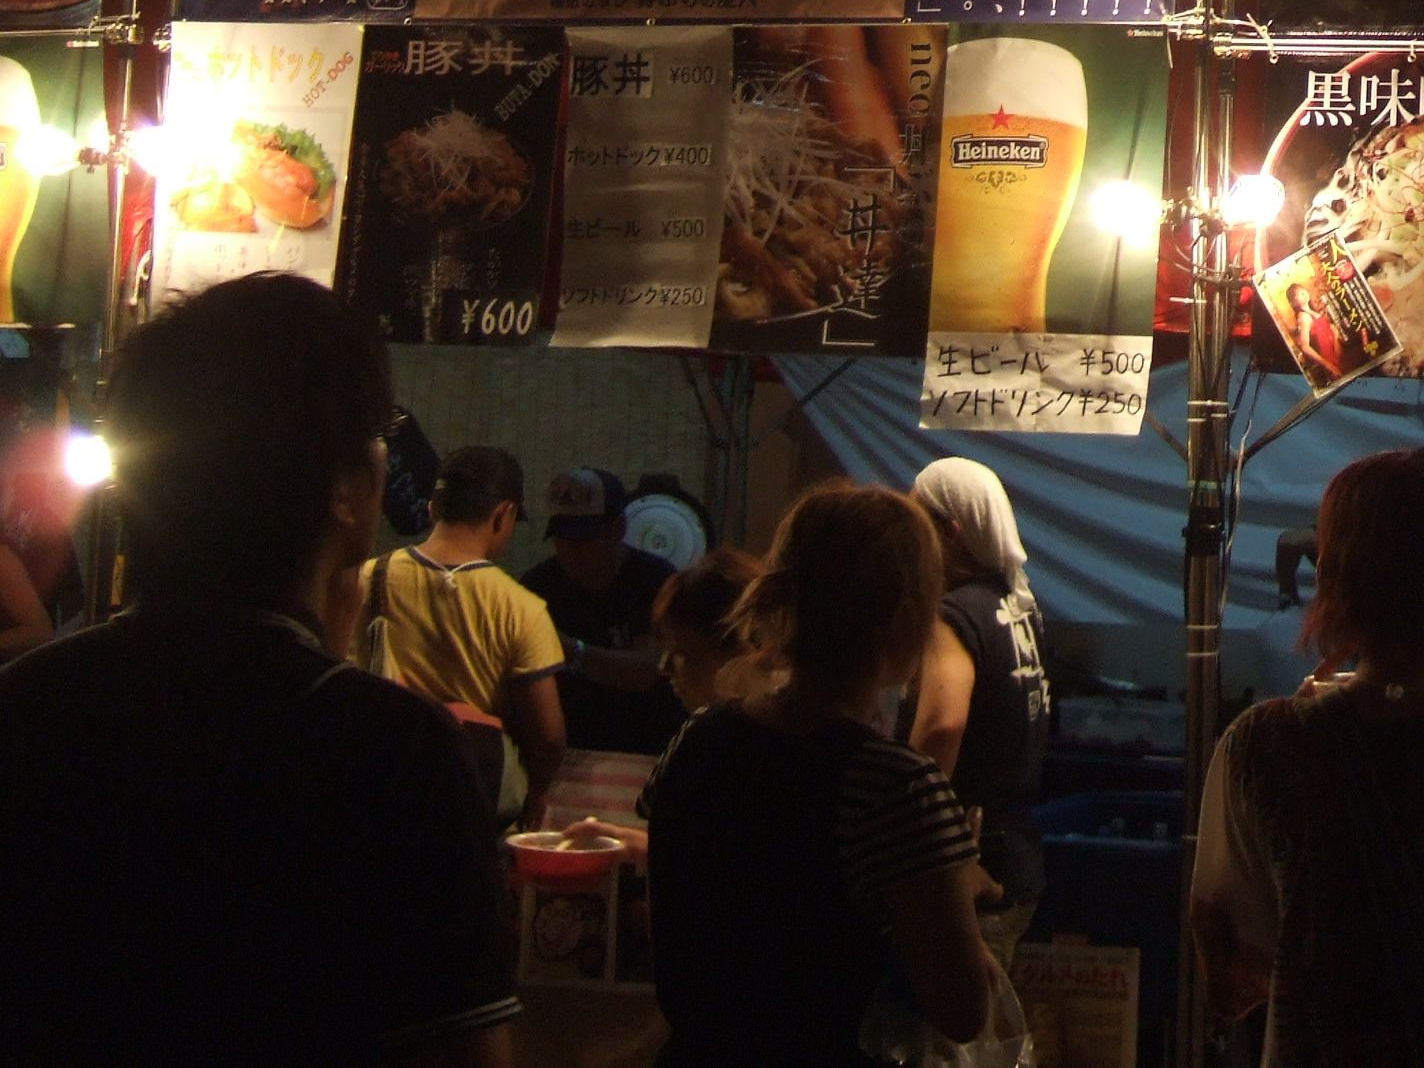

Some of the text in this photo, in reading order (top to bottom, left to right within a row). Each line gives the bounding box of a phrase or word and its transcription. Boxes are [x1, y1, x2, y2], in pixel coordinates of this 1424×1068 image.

[569, 52, 651, 96] 豚丼
[958, 142, 1045, 161] Heineken
[461, 297, 535, 336] ¥600
[938, 347, 1146, 379] 生ビール ¥500
[932, 389, 1143, 417] ソフトドリンク ¥250
